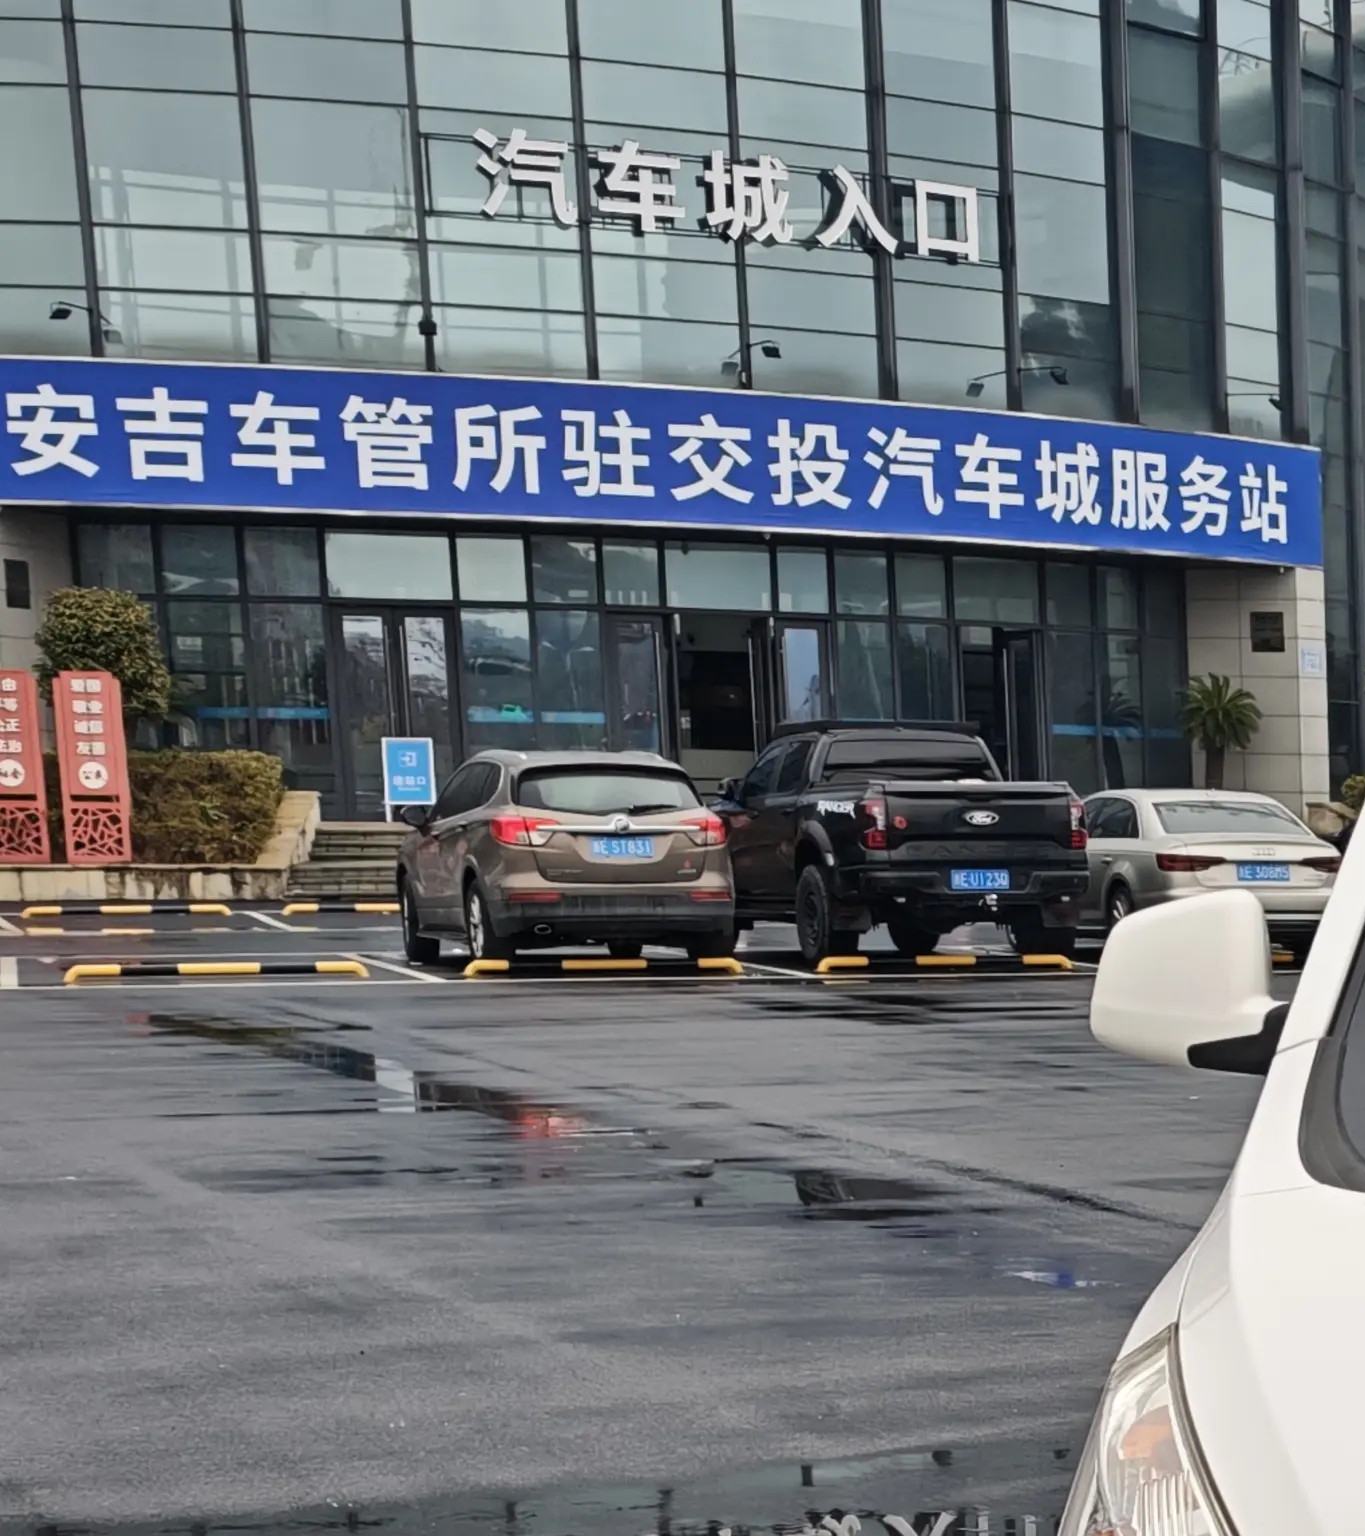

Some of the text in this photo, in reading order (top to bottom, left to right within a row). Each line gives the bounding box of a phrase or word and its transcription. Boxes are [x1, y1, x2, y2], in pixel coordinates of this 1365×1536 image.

[473, 128, 980, 262] 汽车城入口
[5, 383, 1288, 545] 安吉车管所驻交投汽车城服务站
